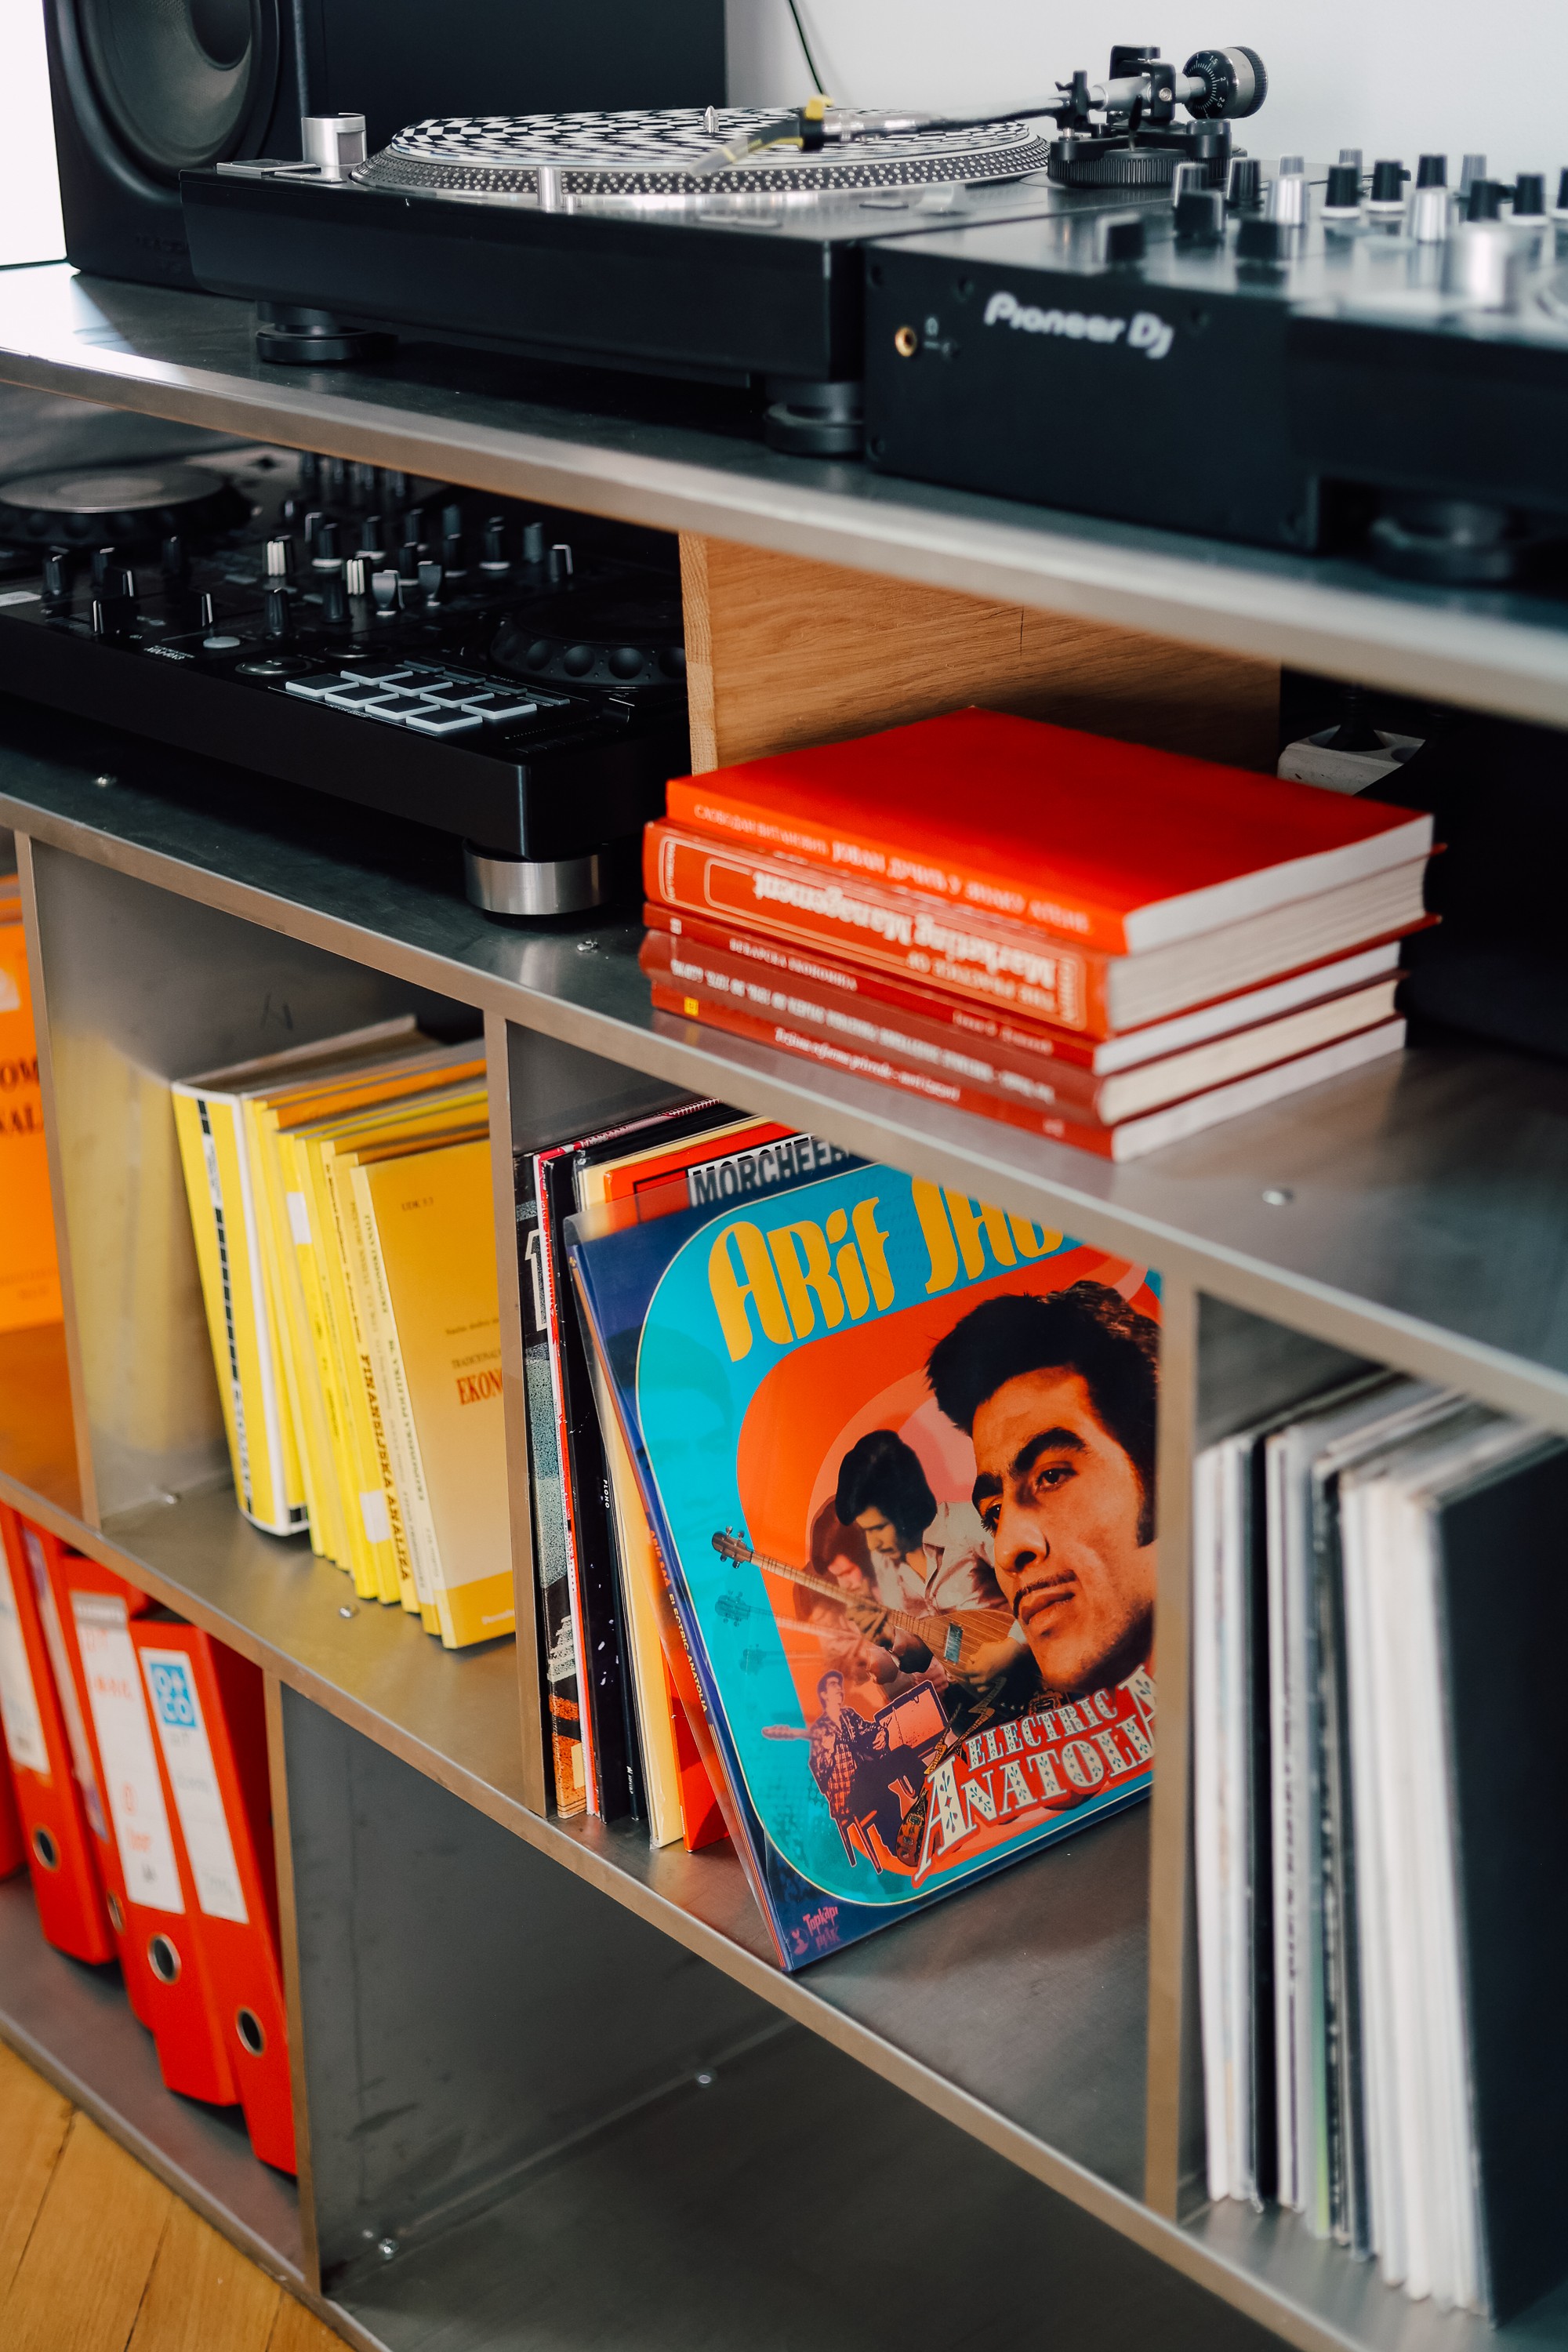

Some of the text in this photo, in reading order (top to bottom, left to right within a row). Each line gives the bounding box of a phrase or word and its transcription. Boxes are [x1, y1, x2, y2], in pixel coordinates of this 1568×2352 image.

[1216, 96, 1226, 109] 2.5
[984, 290, 1126, 343] Pioneer
[753, 869, 1058, 987] Marketing Management
[361, 1353, 409, 1582] FINANSIJSKA ANALIZA
[686, 1653, 708, 1712] ANATOLIA
[965, 1690, 1118, 1773] ELECTRIC
